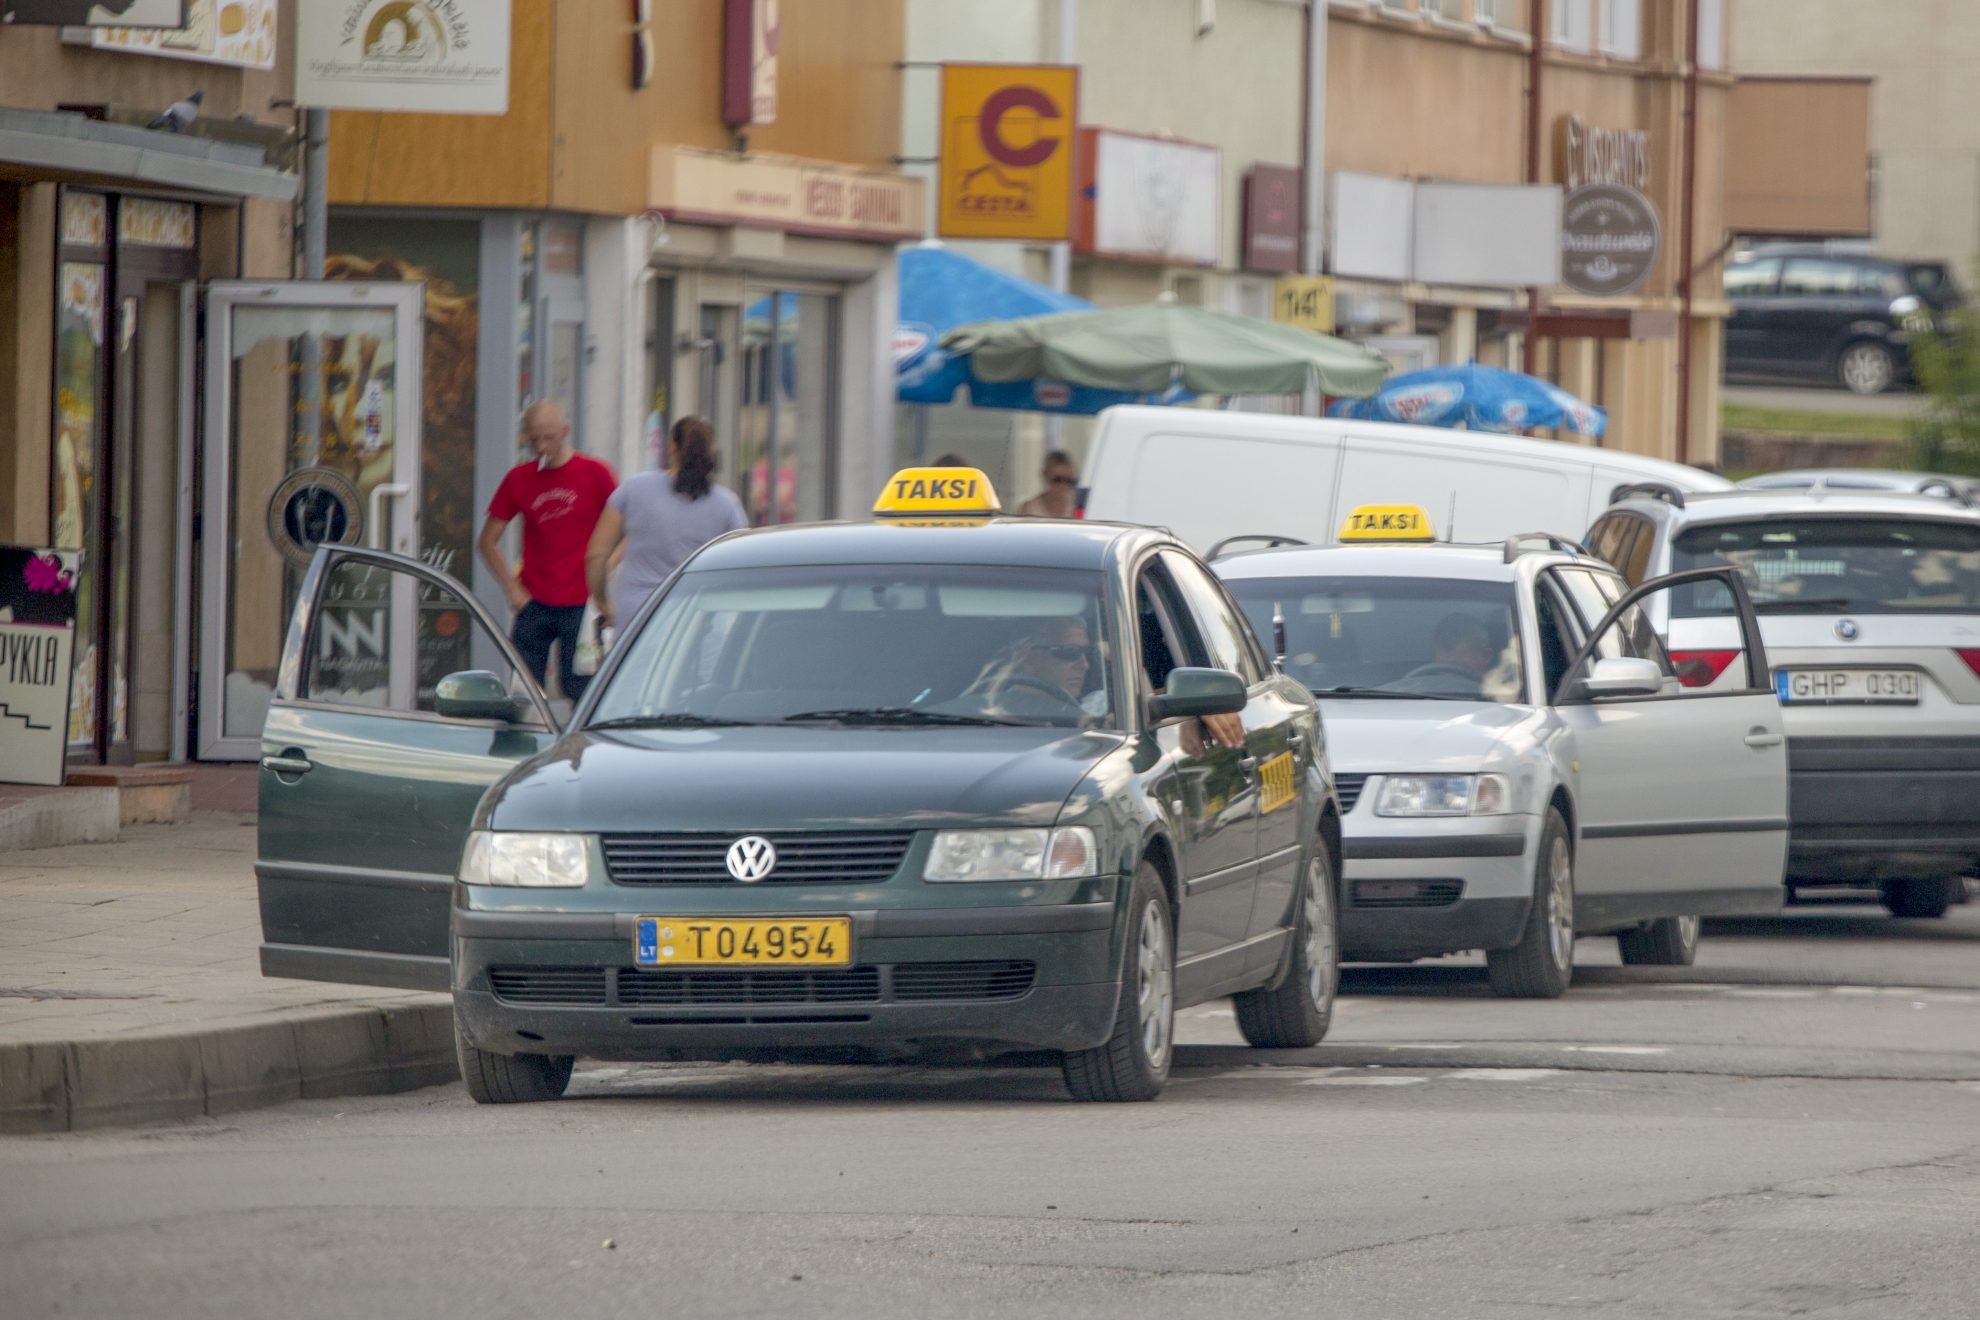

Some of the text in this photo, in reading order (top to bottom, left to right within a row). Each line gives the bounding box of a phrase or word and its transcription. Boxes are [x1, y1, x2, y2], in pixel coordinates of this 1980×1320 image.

[895, 478, 977, 500] TAKSI
[1352, 513, 1420, 530] TAKSI
[1792, 673, 1915, 696] GHP 030
[640, 925, 835, 959] LT T04954
